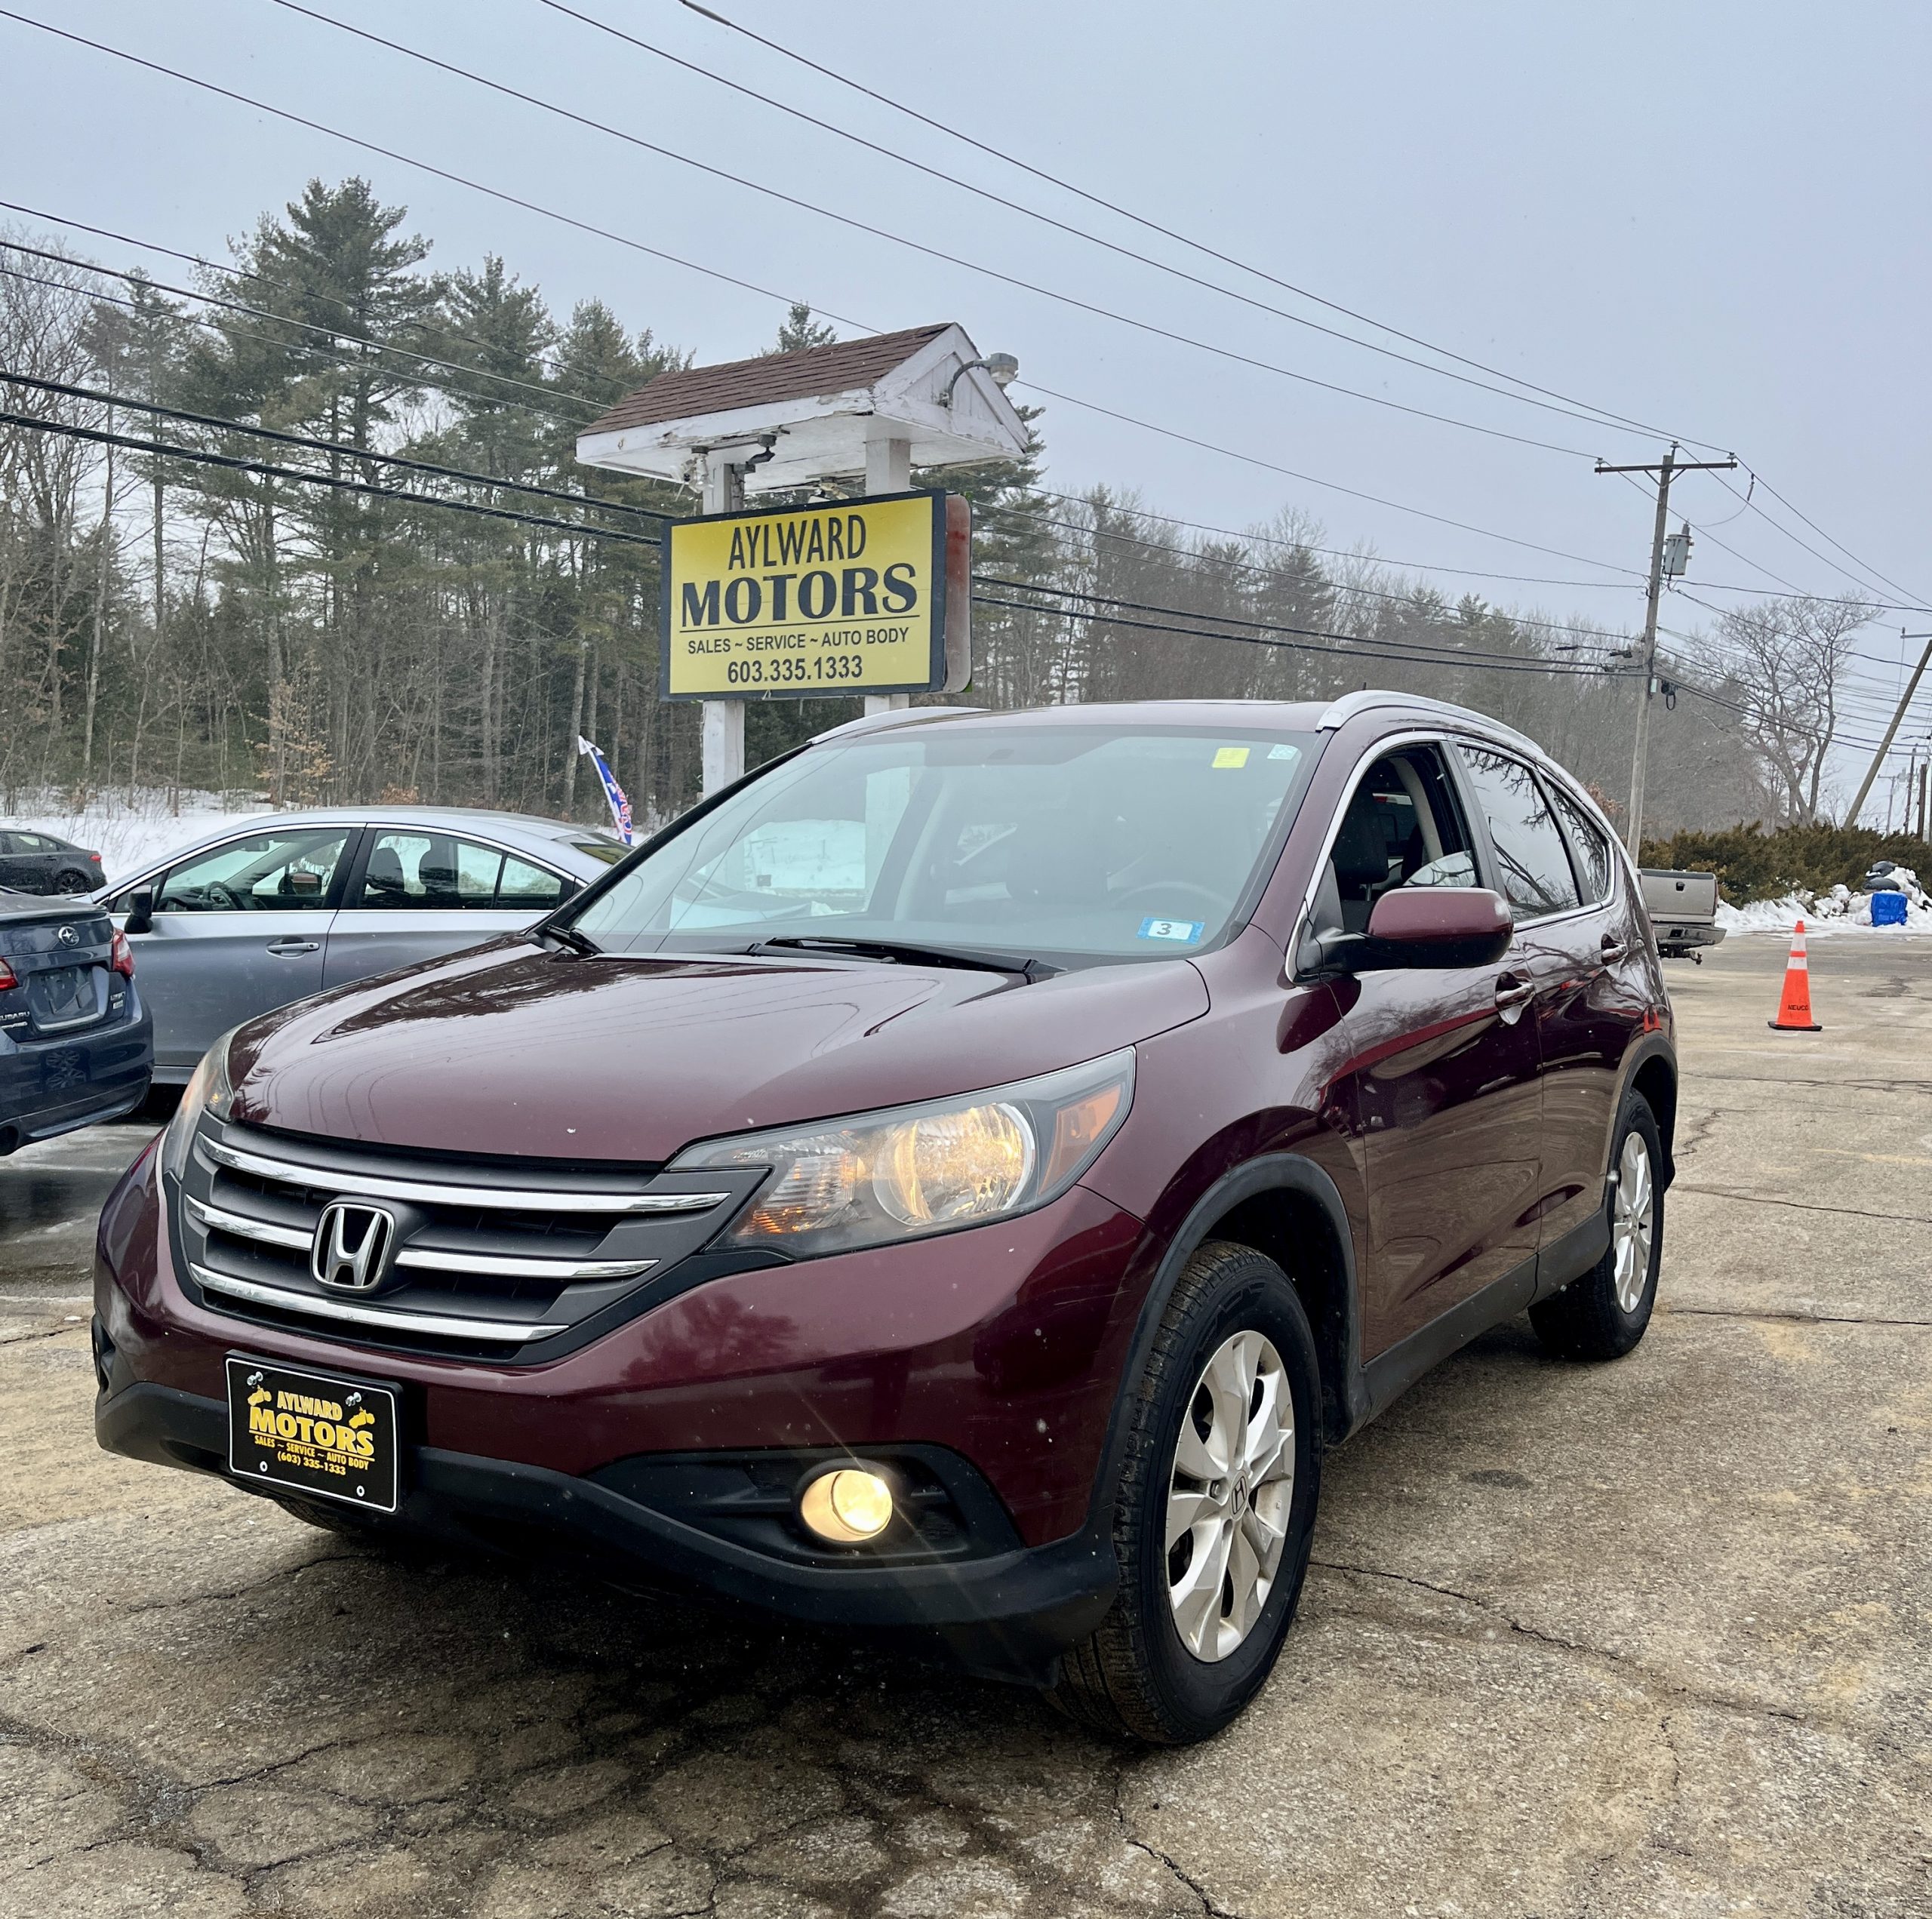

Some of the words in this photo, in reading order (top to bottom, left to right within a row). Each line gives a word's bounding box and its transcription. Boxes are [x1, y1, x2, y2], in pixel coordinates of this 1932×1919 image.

[728, 514, 866, 570] AYLWARD
[681, 563, 918, 628] MOTORS
[688, 638, 731, 654] SALES
[746, 634, 806, 651] SERVICE
[820, 630, 862, 647] AUTO
[866, 627, 909, 644] BODY
[727, 654, 863, 684] 603.335.1333
[1156, 922, 1172, 936] 3
[0, 1011, 30, 1021] UBARU
[276, 1390, 343, 1422] AYLWARD
[248, 1406, 375, 1457] MOTORS
[254, 1435, 275, 1448] SALES
[286, 1442, 315, 1457] SERVICE
[326, 1452, 347, 1465] AUTO
[348, 1456, 369, 1471] BODY
[277, 1450, 301, 1466] (603)
[303, 1456, 346, 1476] 335-1333
